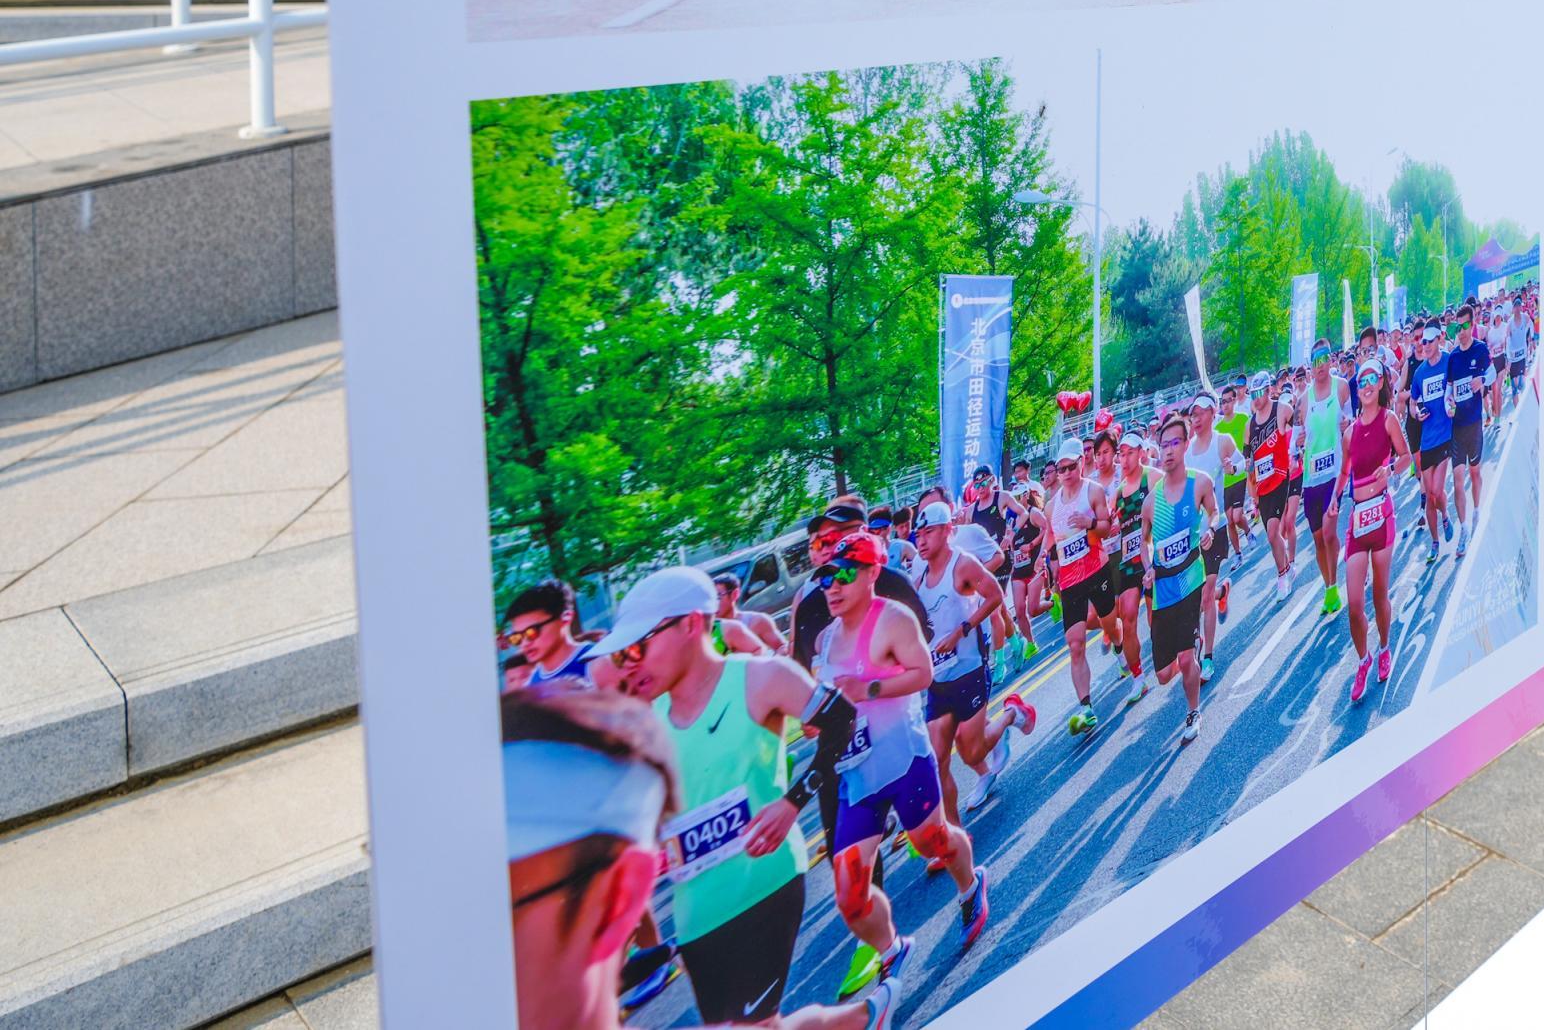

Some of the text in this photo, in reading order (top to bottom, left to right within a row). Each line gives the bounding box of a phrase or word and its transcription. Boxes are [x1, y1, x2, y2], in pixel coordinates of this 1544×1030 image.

[962, 318, 988, 492] 北京市田径运动协
[1361, 505, 1383, 523] 5281
[1065, 539, 1086, 557] 1092
[1165, 539, 1189, 557] 0504
[683, 806, 744, 853] 0402
